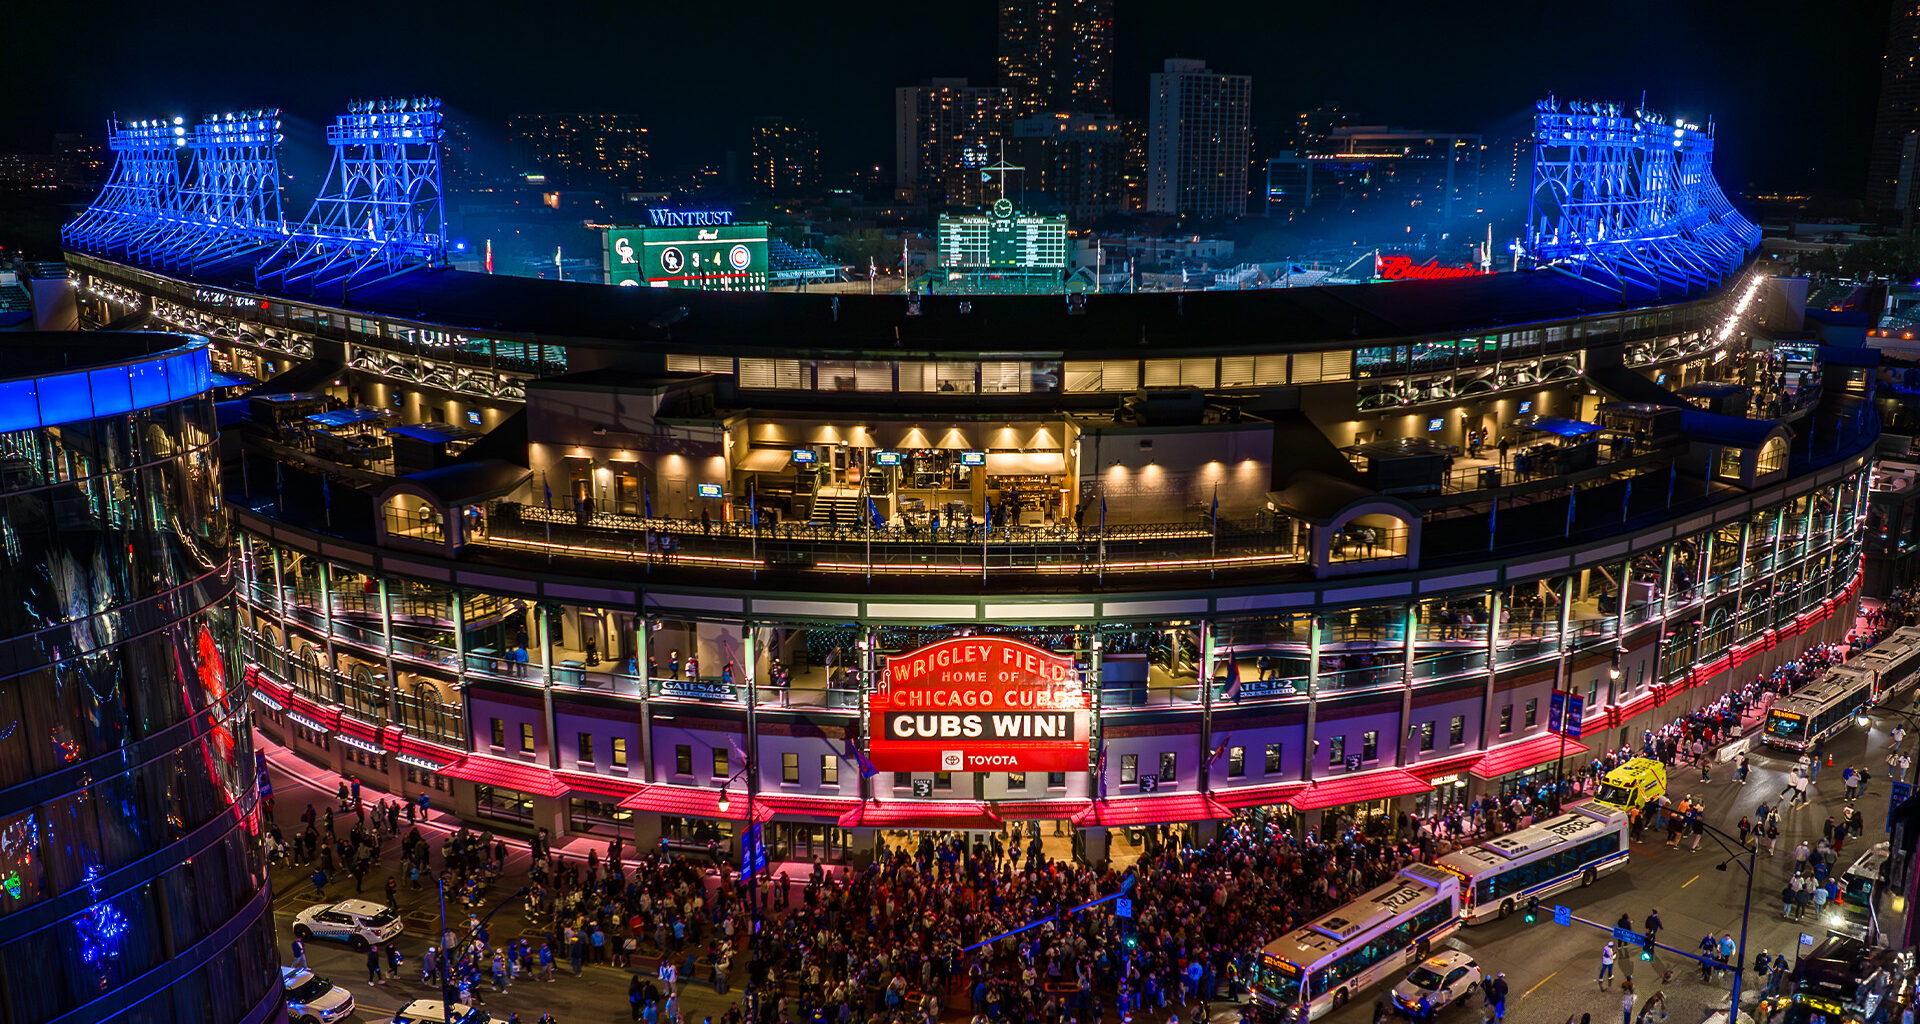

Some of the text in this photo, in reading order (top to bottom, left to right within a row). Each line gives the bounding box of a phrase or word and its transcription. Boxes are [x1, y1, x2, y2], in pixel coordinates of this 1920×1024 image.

[1016, 217, 1045, 225] AMERICAN
[713, 251, 721, 266] 4
[893, 644, 1067, 683] WRIGLEY FIELD
[941, 671, 1020, 682] HOME OF
[661, 681, 707, 692] GATES
[893, 689, 993, 707] CHICAGO
[893, 714, 1067, 738] CUBS WIN!
[968, 755, 1018, 766] TOYOTA
[916, 783, 929, 797] 3
[1381, 889, 1421, 909] 8724
